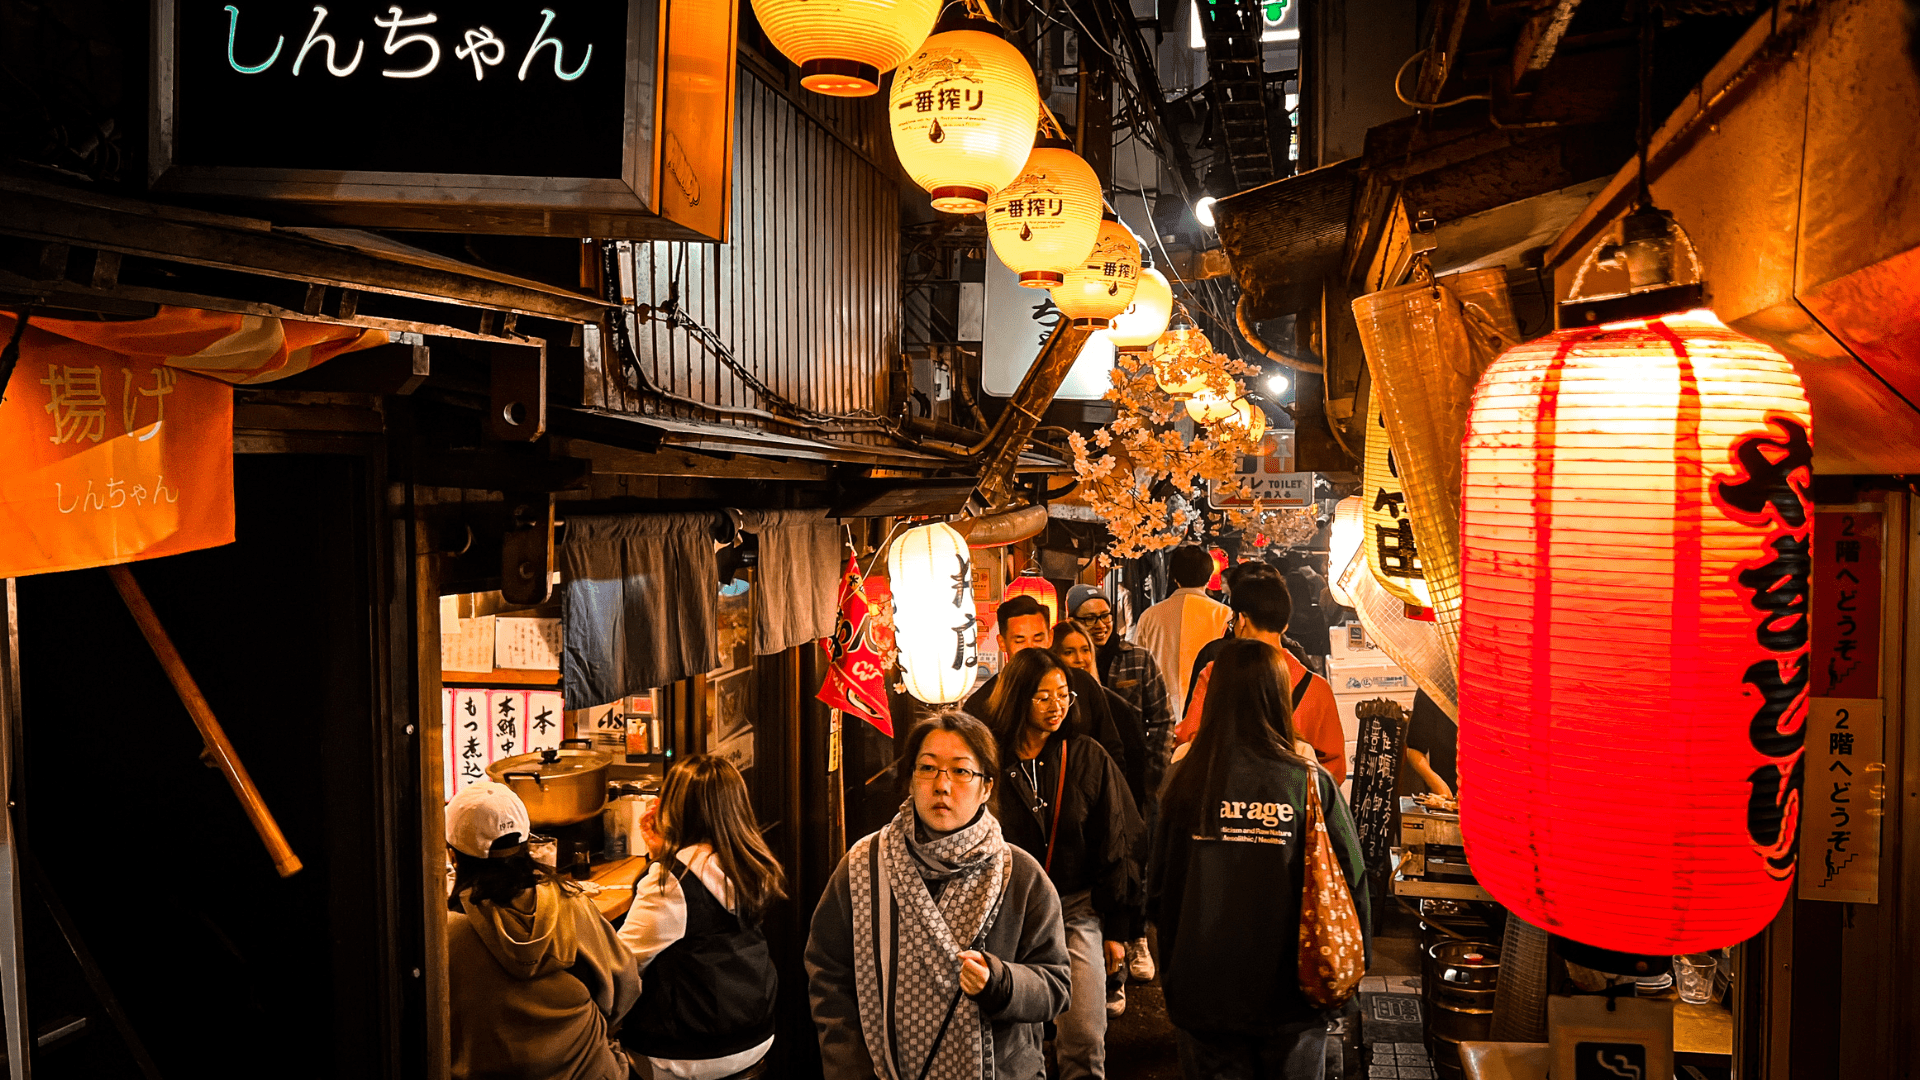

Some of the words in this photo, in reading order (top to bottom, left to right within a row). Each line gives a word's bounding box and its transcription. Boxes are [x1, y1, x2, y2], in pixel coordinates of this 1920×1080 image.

[224, 5, 592, 80] しんちゃん
[898, 87, 984, 113] 一番搾り
[994, 198, 1062, 217] 一番搾り
[1087, 262, 1138, 279] 一番搾り
[40, 363, 177, 446] 揚げ
[55, 474, 179, 515] しんちゃん
[1268, 480, 1302, 489] TOILET
[1834, 515, 1861, 661] 2階へどうぞ
[496, 695, 516, 758] 本鮪中
[598, 707, 625, 730] As
[461, 696, 484, 784] もつ煮込
[1828, 708, 1854, 852] 2階へどうぞ
[1220, 800, 1294, 827] arage
[1258, 837, 1287, 845] Neolithic
[1270, 828, 1293, 838] Nature
